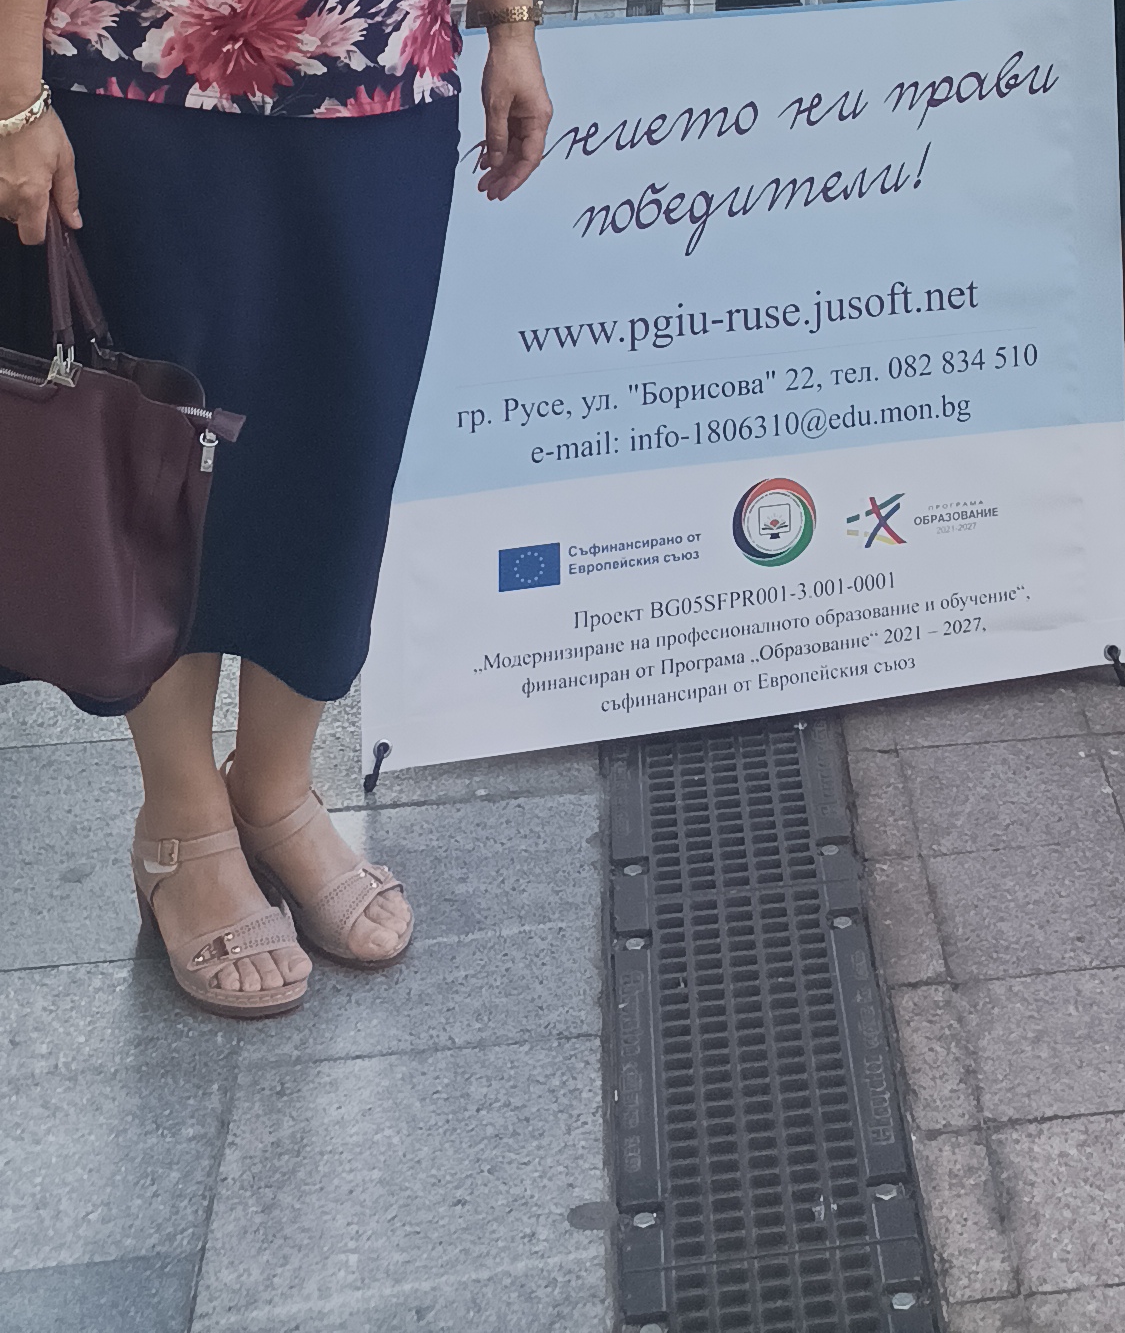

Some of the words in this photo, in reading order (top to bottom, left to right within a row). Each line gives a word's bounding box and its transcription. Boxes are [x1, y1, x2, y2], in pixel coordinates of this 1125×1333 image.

[777, 89, 869, 130] ни
[884, 50, 1060, 131] прави
[572, 141, 932, 257] победители!
[518, 280, 980, 353] www.pgiu-ruse.jusoft.net
[457, 407, 492, 434] гр.
[501, 397, 573, 427] Русе,
[581, 393, 618, 420] ул.
[628, 370, 777, 409] "Борисова"
[785, 366, 823, 393] 22,
[830, 365, 879, 386] тел.
[888, 353, 933, 380] 082
[941, 348, 986, 375] 834
[994, 343, 1039, 370] 510
[530, 430, 620, 464] e-mail:
[629, 394, 972, 452] info-1806310@edu.mon.bg
[913, 507, 999, 526] ОБРАЗОВАНИЕ
[928, 500, 984, 511] ПРОГРАМА
[567, 534, 683, 558] Съфинансирано
[686, 532, 702, 543] от
[568, 553, 660, 576] Европейския
[663, 550, 700, 564] съюз
[473, 639, 625, 674] „Модернизиране
[630, 636, 651, 651] на
[655, 615, 811, 651] професионалното
[815, 601, 920, 629] образование
[925, 599, 936, 612] и
[573, 607, 644, 632] Проект
[650, 571, 896, 619] BG05SFPR001-3.001-0001
[521, 668, 630, 699] финансиран
[635, 664, 656, 680] от
[660, 652, 745, 678] Програма
[884, 625, 922, 646] 2021
[600, 681, 728, 714] съфинансиран
[733, 679, 752, 694] от
[758, 663, 869, 693] Европейския
[873, 657, 917, 675] съюз
